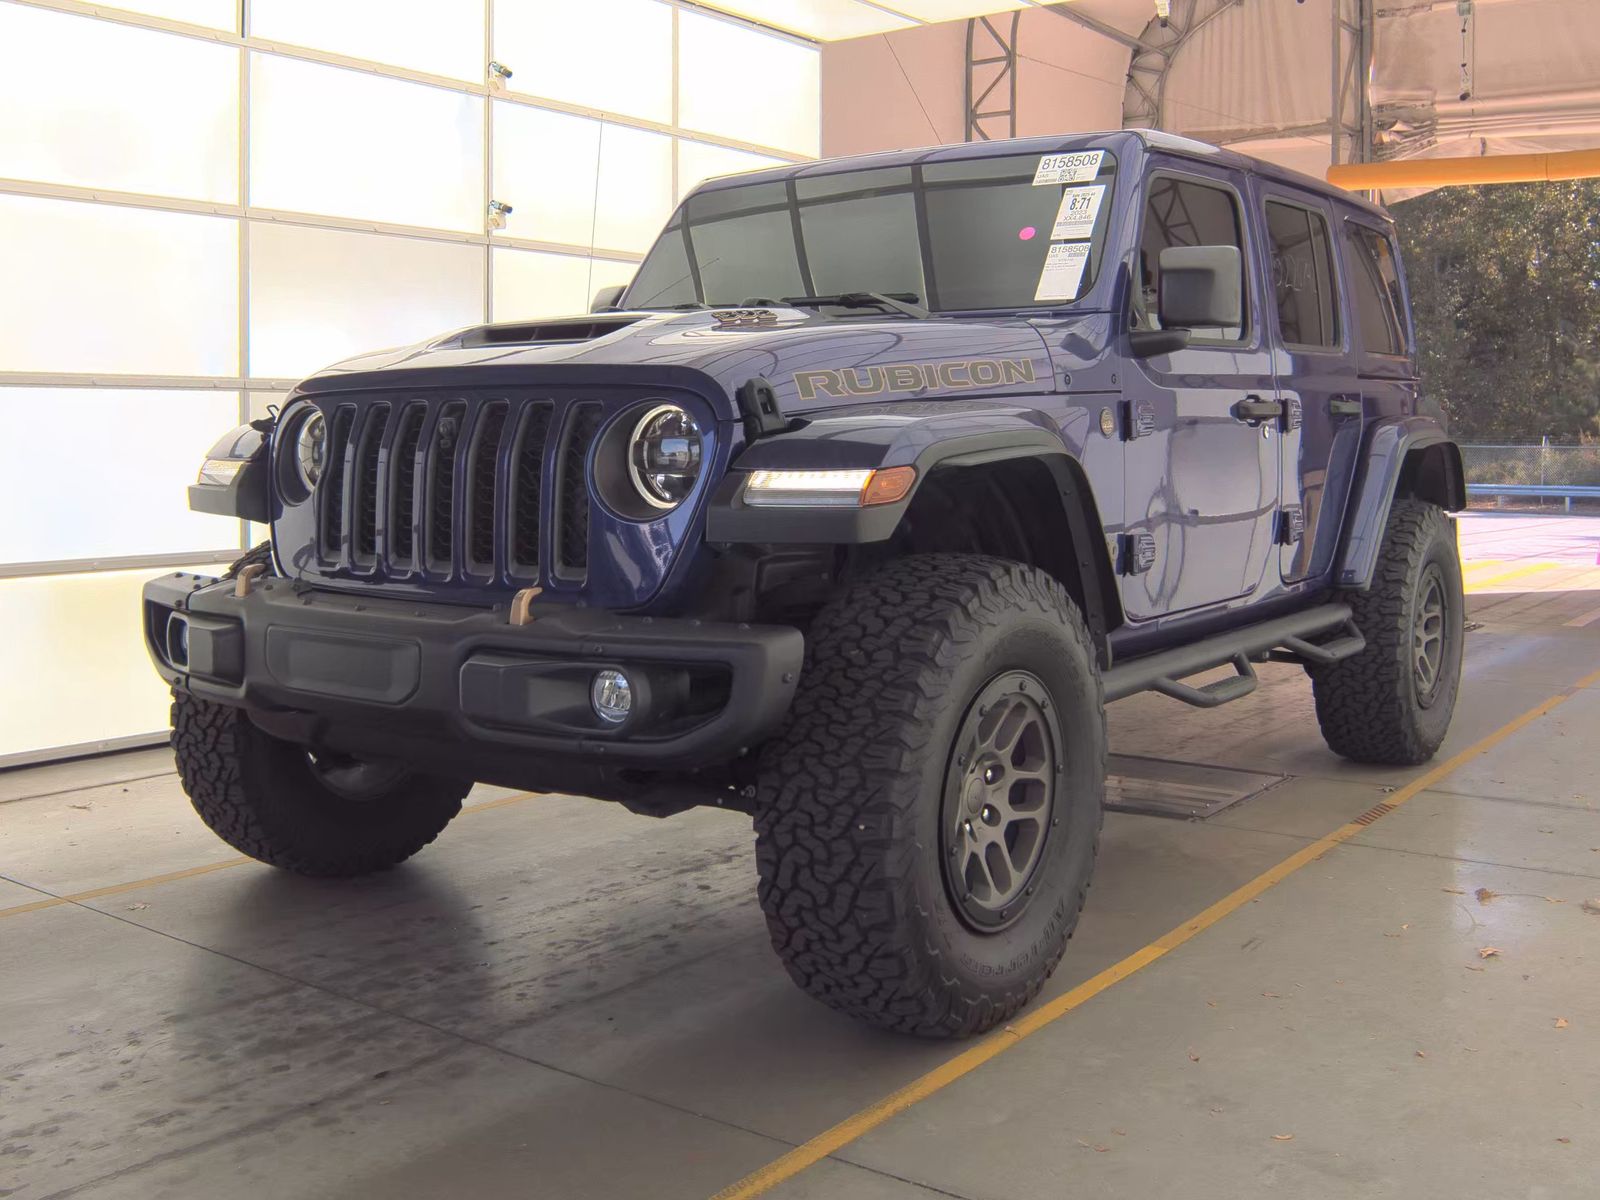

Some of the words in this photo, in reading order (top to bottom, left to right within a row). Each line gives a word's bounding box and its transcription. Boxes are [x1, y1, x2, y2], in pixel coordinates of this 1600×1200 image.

[1042, 154, 1098, 170] 8158508
[1070, 197, 1091, 210] 8:71
[1051, 245, 1089, 253] 8158508
[793, 358, 1036, 400] RUBICON
